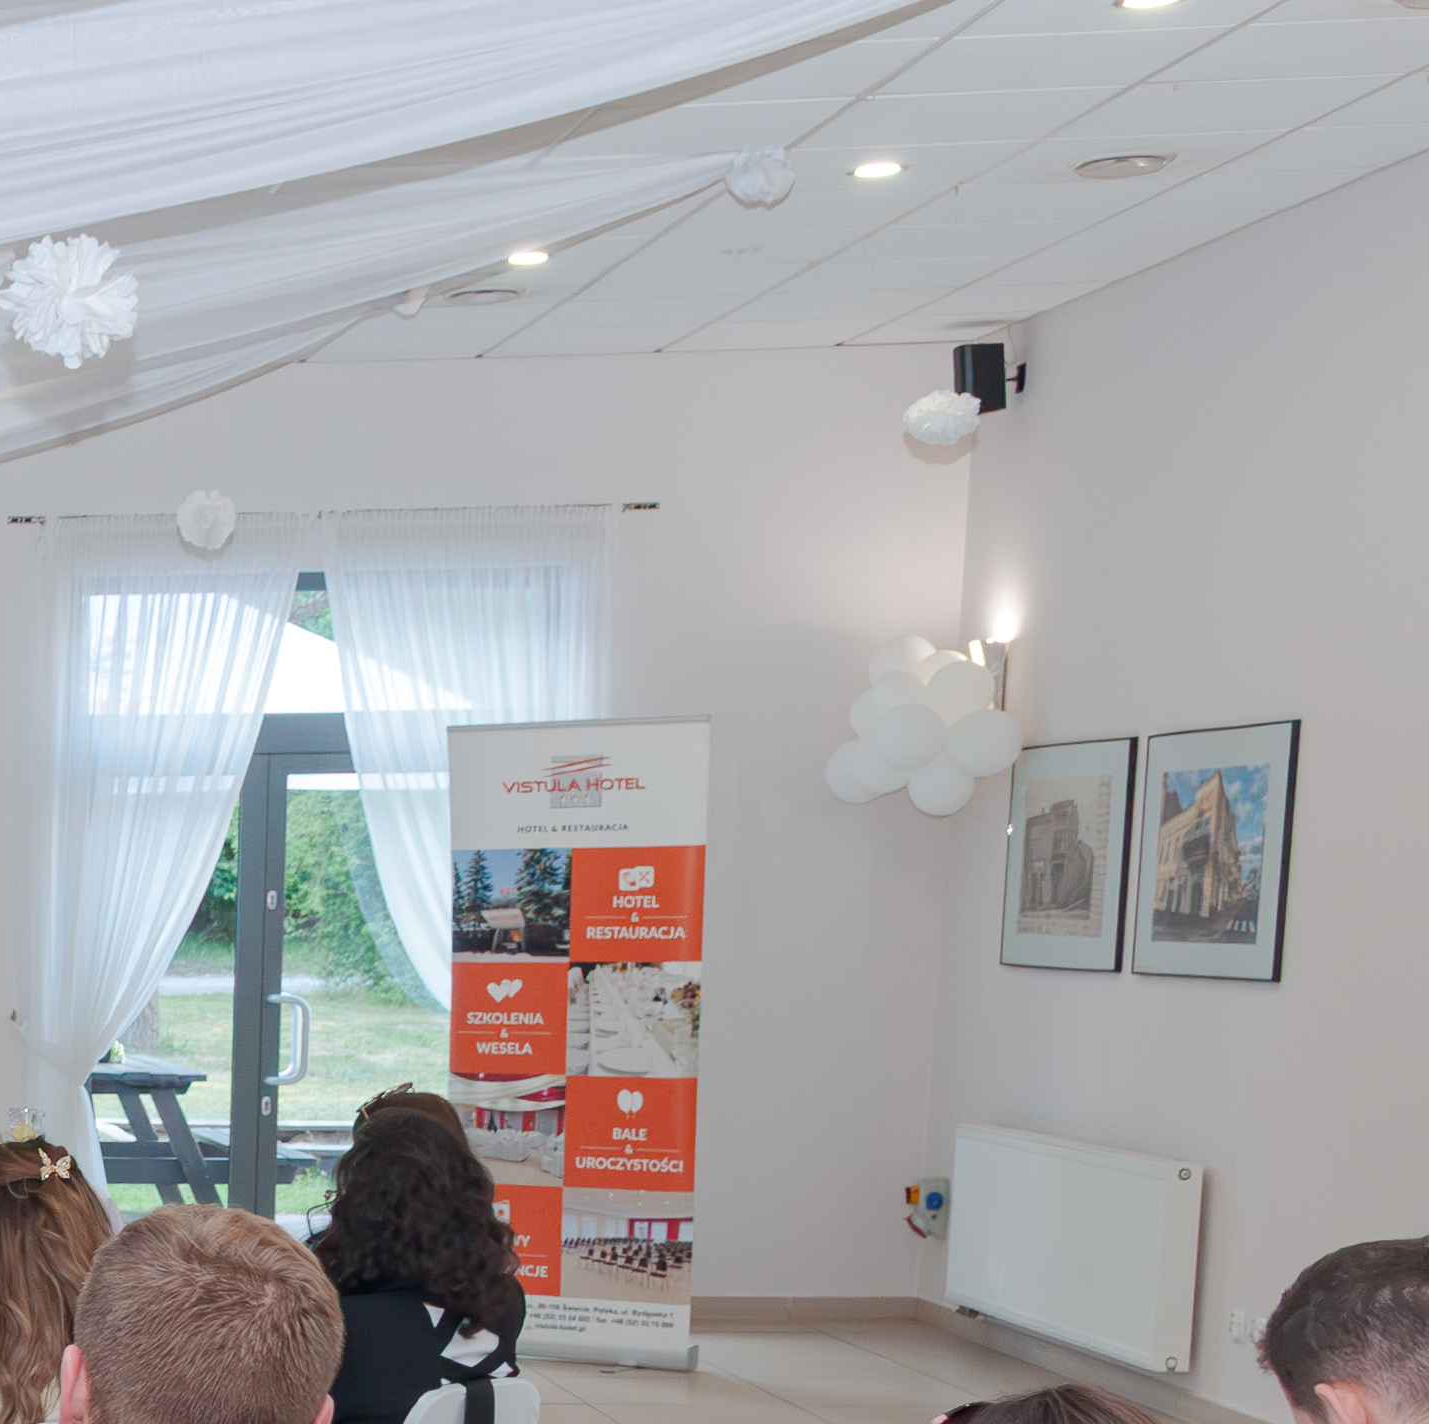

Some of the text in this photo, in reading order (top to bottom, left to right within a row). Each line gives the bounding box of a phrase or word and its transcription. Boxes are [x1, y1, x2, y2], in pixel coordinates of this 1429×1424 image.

[502, 777, 646, 794] VISTULA HOTEL
[517, 824, 548, 833] HOTEL
[561, 823, 629, 832] RESTAURACJA
[612, 895, 659, 909] HOTEL
[630, 911, 639, 923] &
[586, 926, 686, 939] RESTAURACJA
[467, 1012, 544, 1025] SZKOLENIA
[500, 1028, 509, 1038] &
[476, 1041, 533, 1055] WESELA
[612, 1127, 648, 1141] BALE
[625, 1144, 633, 1154] &
[575, 1156, 683, 1173] UROCZYSTOŚCI
